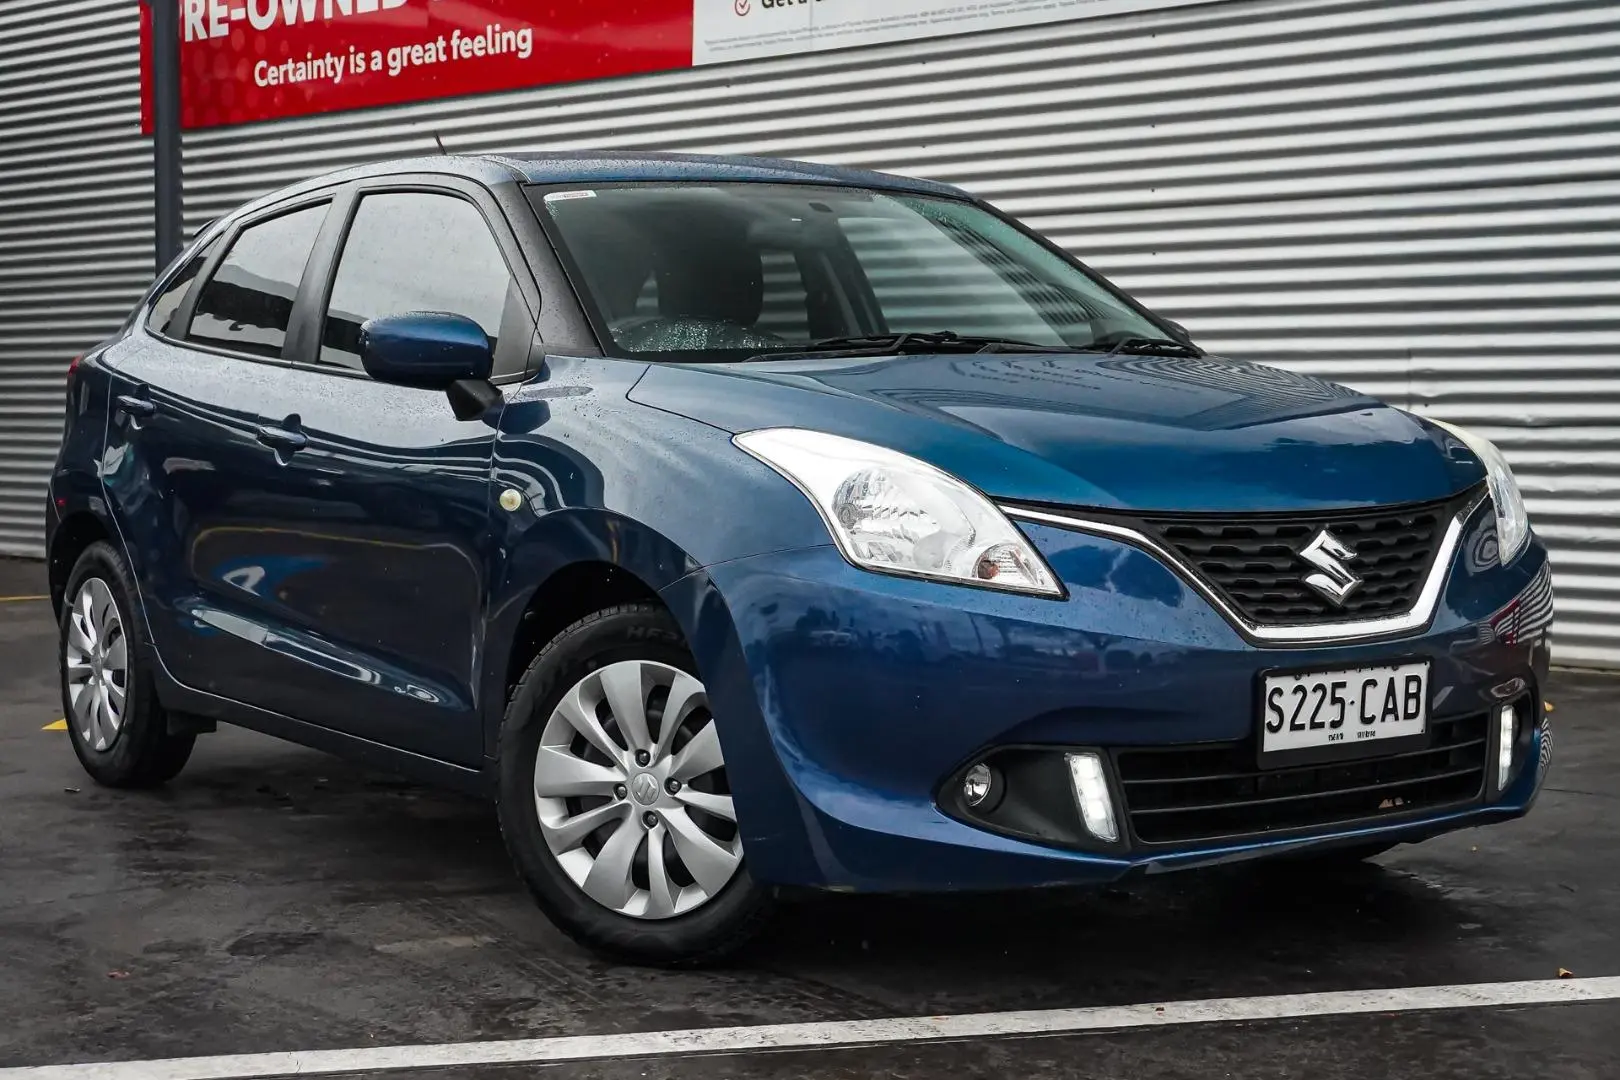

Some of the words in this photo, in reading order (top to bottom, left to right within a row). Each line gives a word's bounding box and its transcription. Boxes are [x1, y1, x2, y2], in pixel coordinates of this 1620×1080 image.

[179, 0, 407, 42] RE-OW
[254, 52, 346, 87] Certainty
[350, 46, 366, 74] is
[370, 50, 382, 71] a
[388, 37, 446, 76] great
[450, 24, 533, 60] feeling
